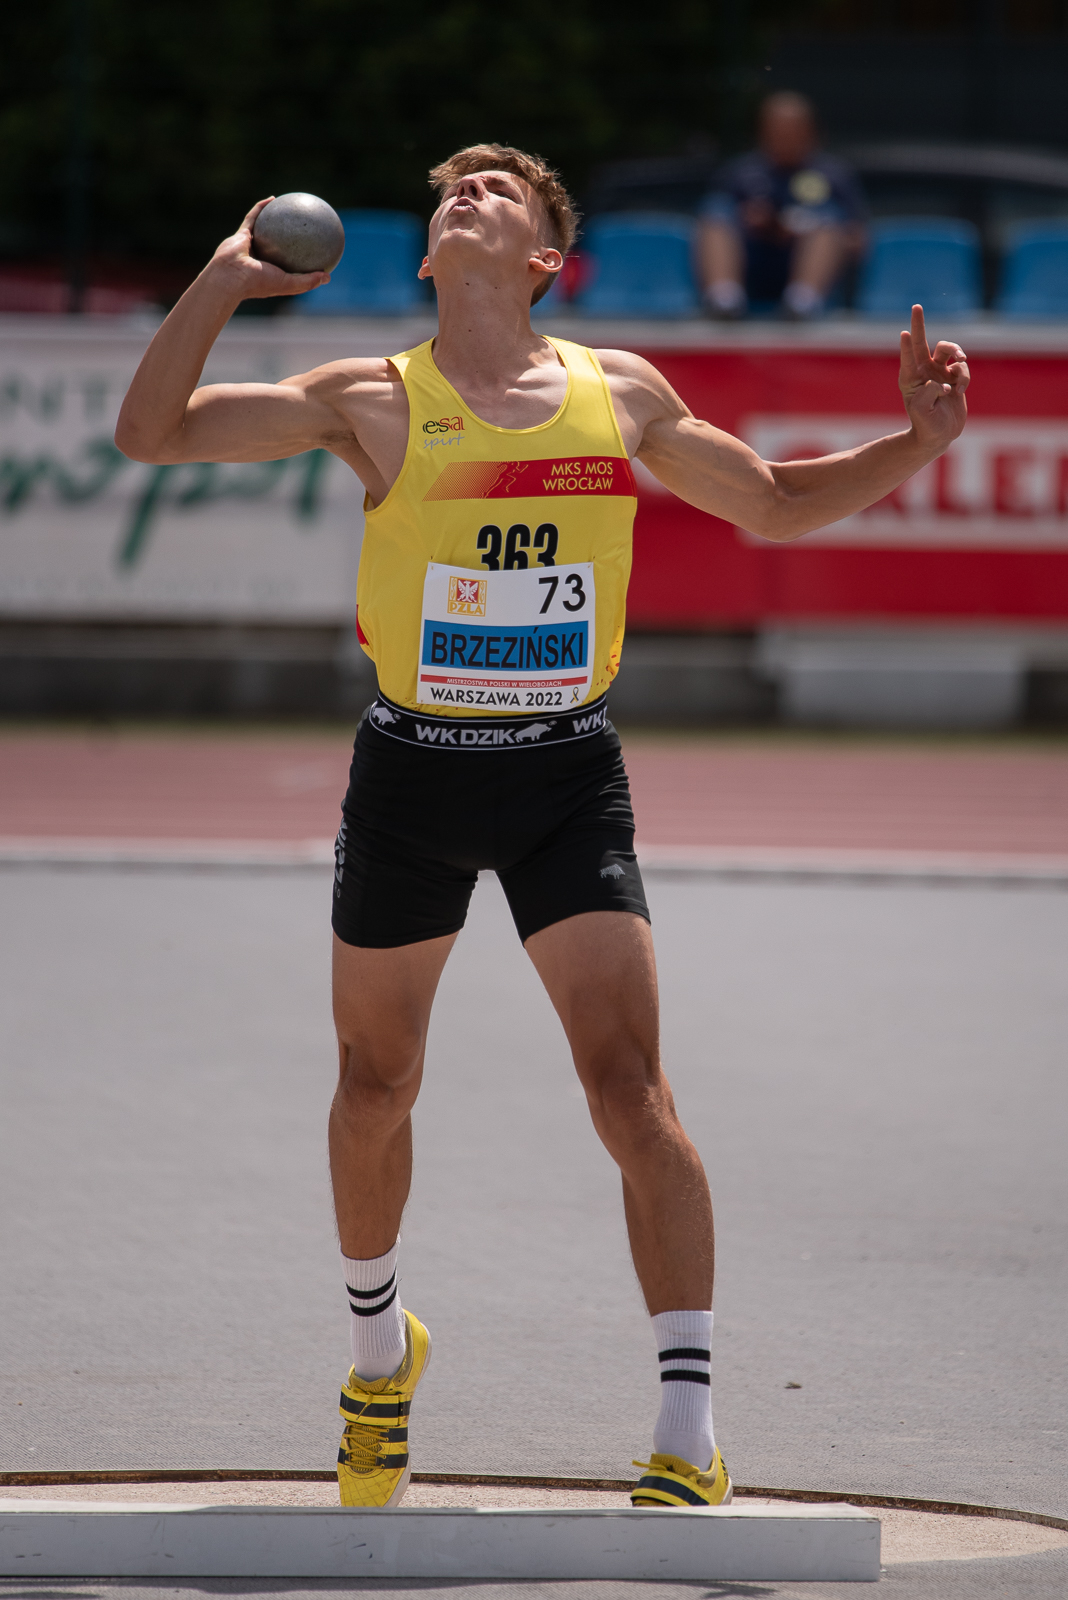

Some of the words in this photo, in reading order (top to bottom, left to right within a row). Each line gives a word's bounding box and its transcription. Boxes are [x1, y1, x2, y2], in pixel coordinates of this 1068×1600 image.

[551, 461, 581, 476] MKS
[584, 461, 613, 475] MOS
[542, 477, 613, 491] WROCŁAW
[476, 522, 559, 571] 363
[538, 573, 586, 614] 73
[449, 602, 484, 615] PZLA
[430, 627, 584, 668] BRZEZIŃSKI
[446, 678, 488, 687] MISTRZOSTWA
[430, 687, 521, 706] WARSZAWA
[525, 691, 563, 706] 2022
[415, 723, 458, 745] WK
[460, 728, 516, 745] DZIK
